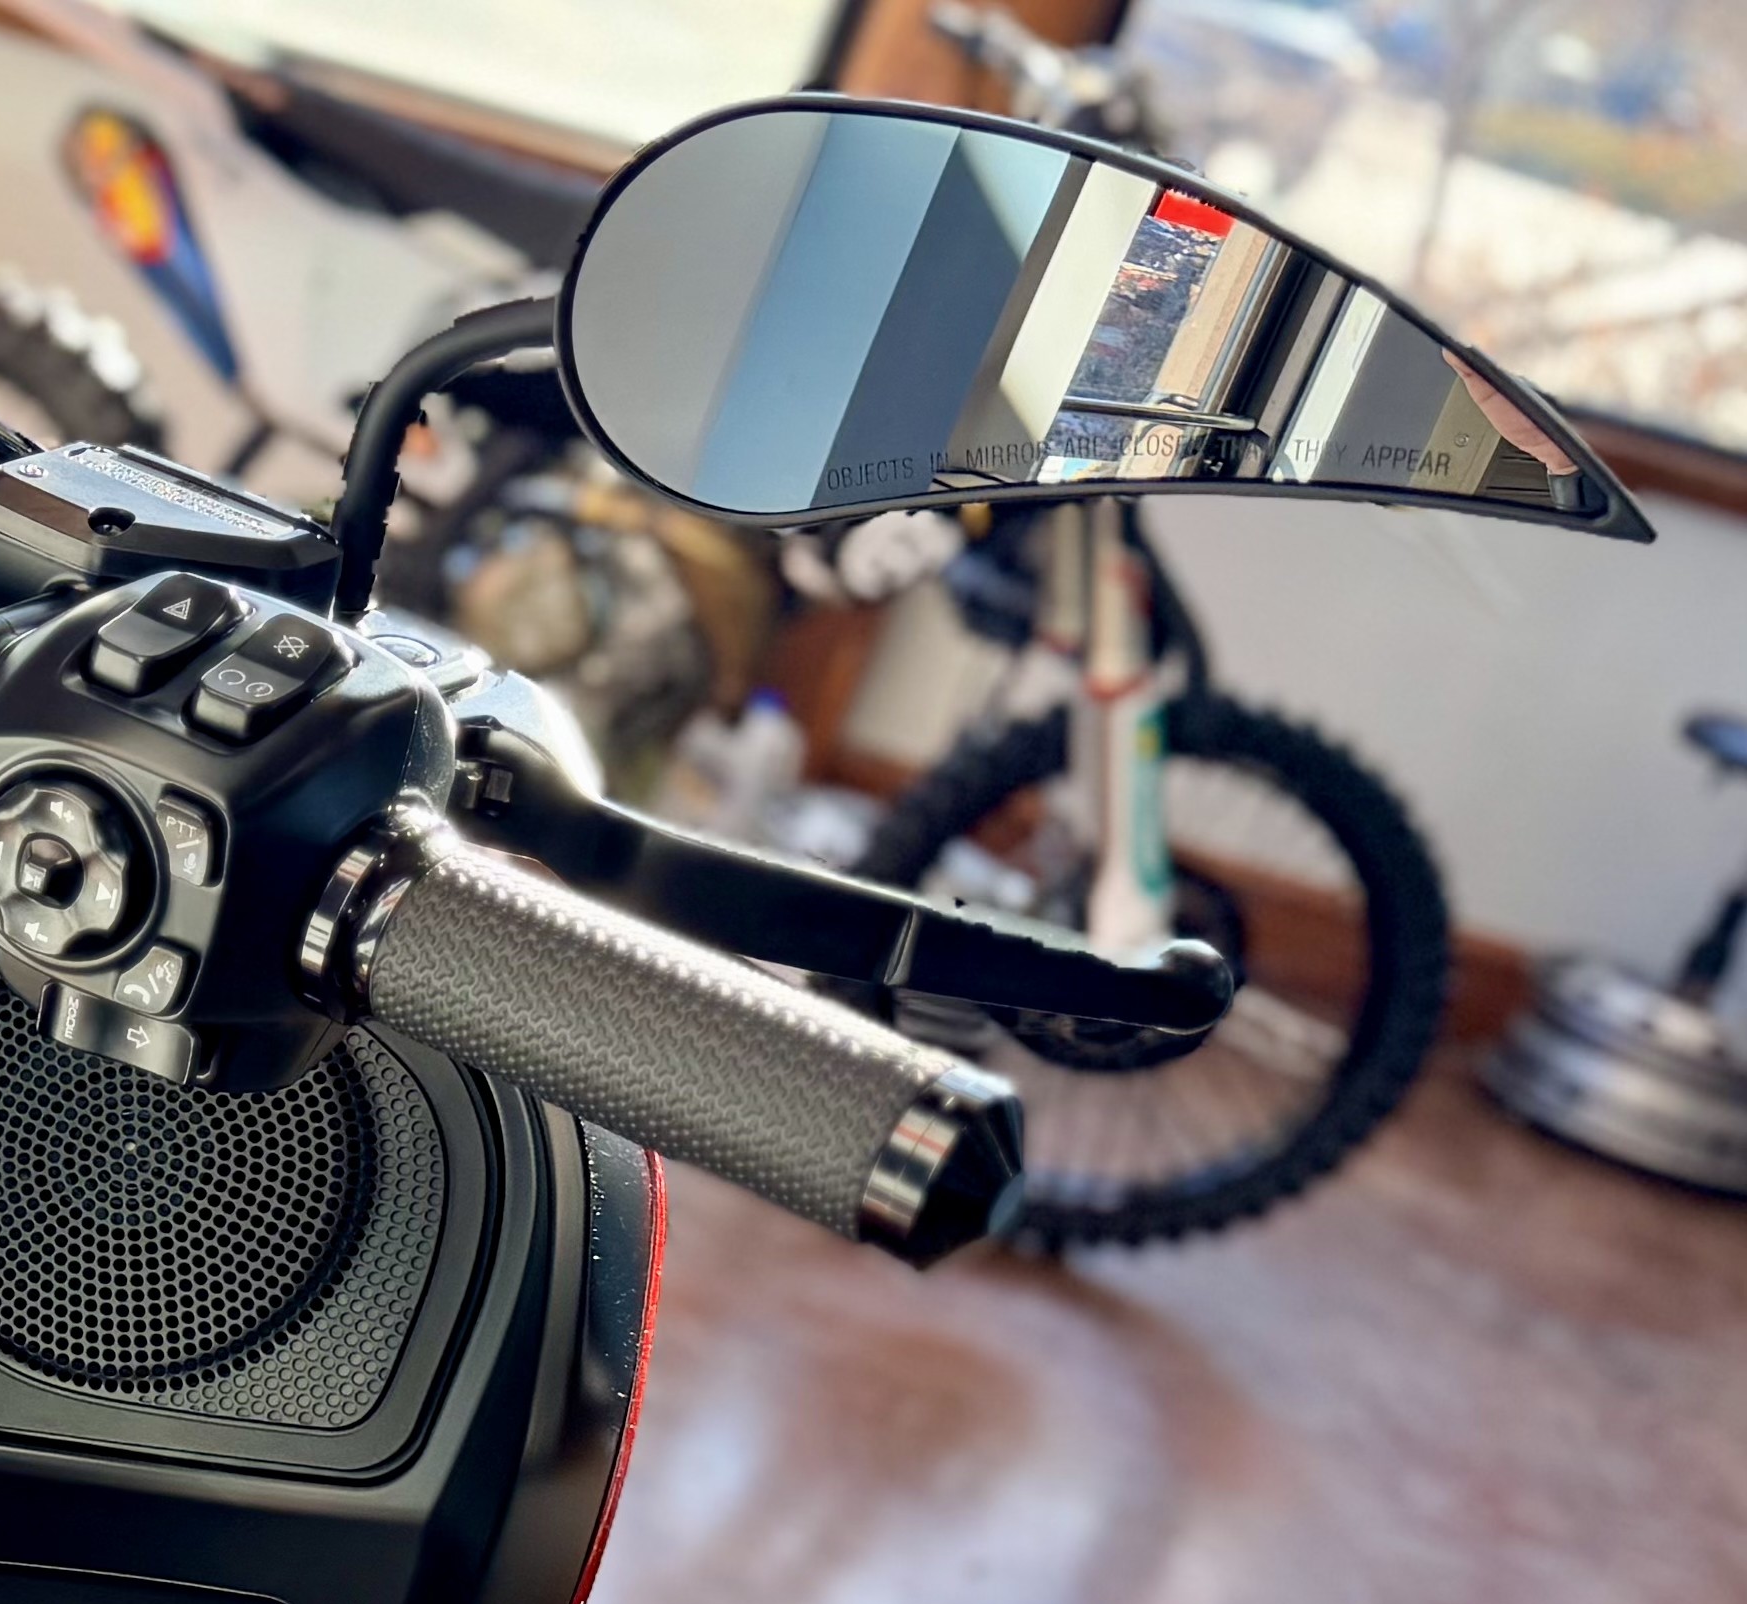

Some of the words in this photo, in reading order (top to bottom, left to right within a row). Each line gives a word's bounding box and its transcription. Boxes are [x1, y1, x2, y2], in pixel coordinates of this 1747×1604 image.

[827, 456, 914, 491] OBJECTS
[1362, 445, 1452, 476] APPEAR
[165, 815, 197, 838] PTT
[64, 995, 80, 1040] MODE
